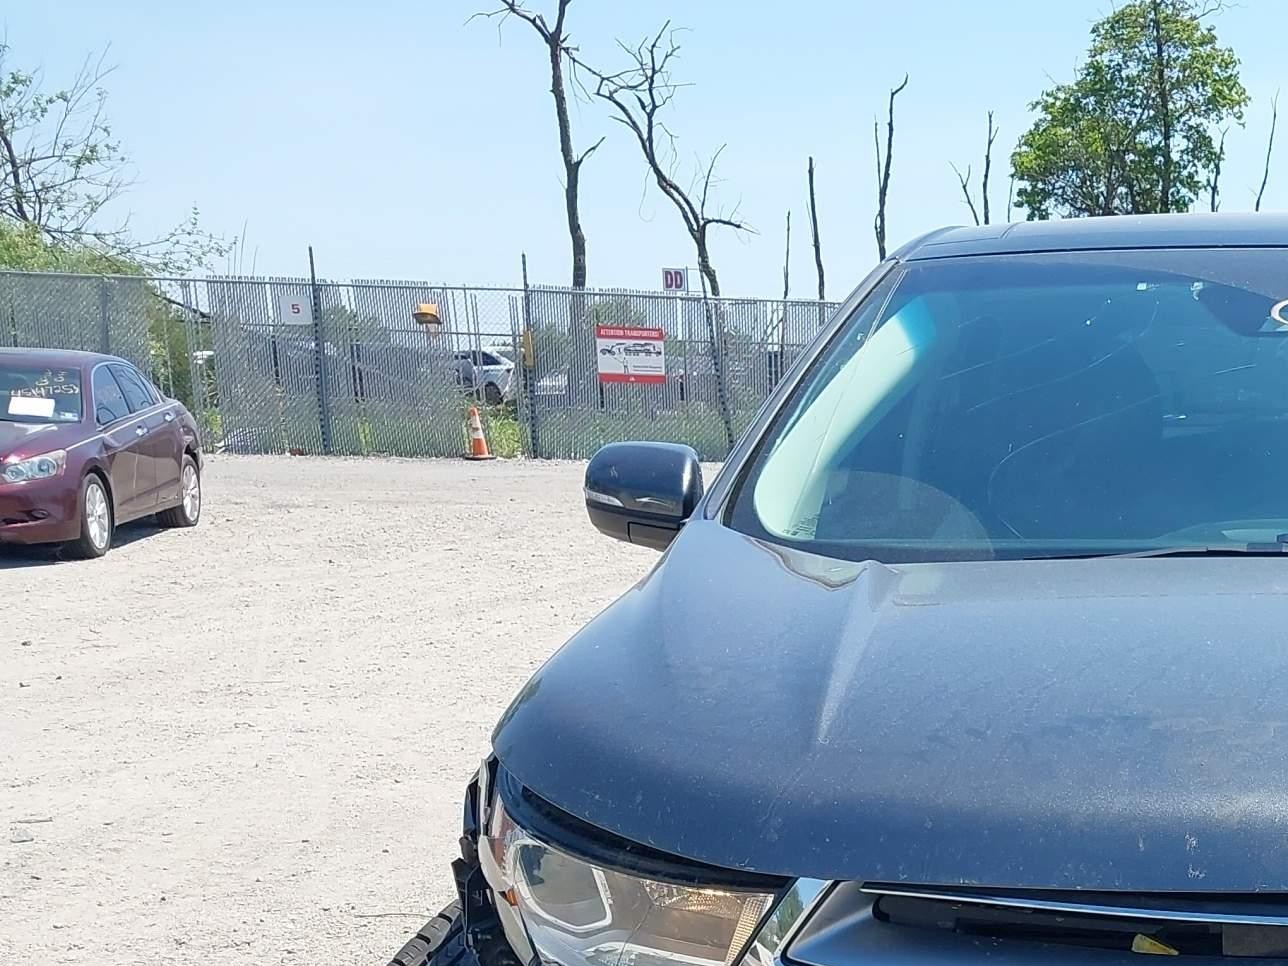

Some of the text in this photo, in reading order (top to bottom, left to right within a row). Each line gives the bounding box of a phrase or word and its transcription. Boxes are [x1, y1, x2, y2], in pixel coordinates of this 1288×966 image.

[664, 270, 684, 289] DD
[291, 303, 301, 314] 5
[600, 328, 624, 336] ATTENTION
